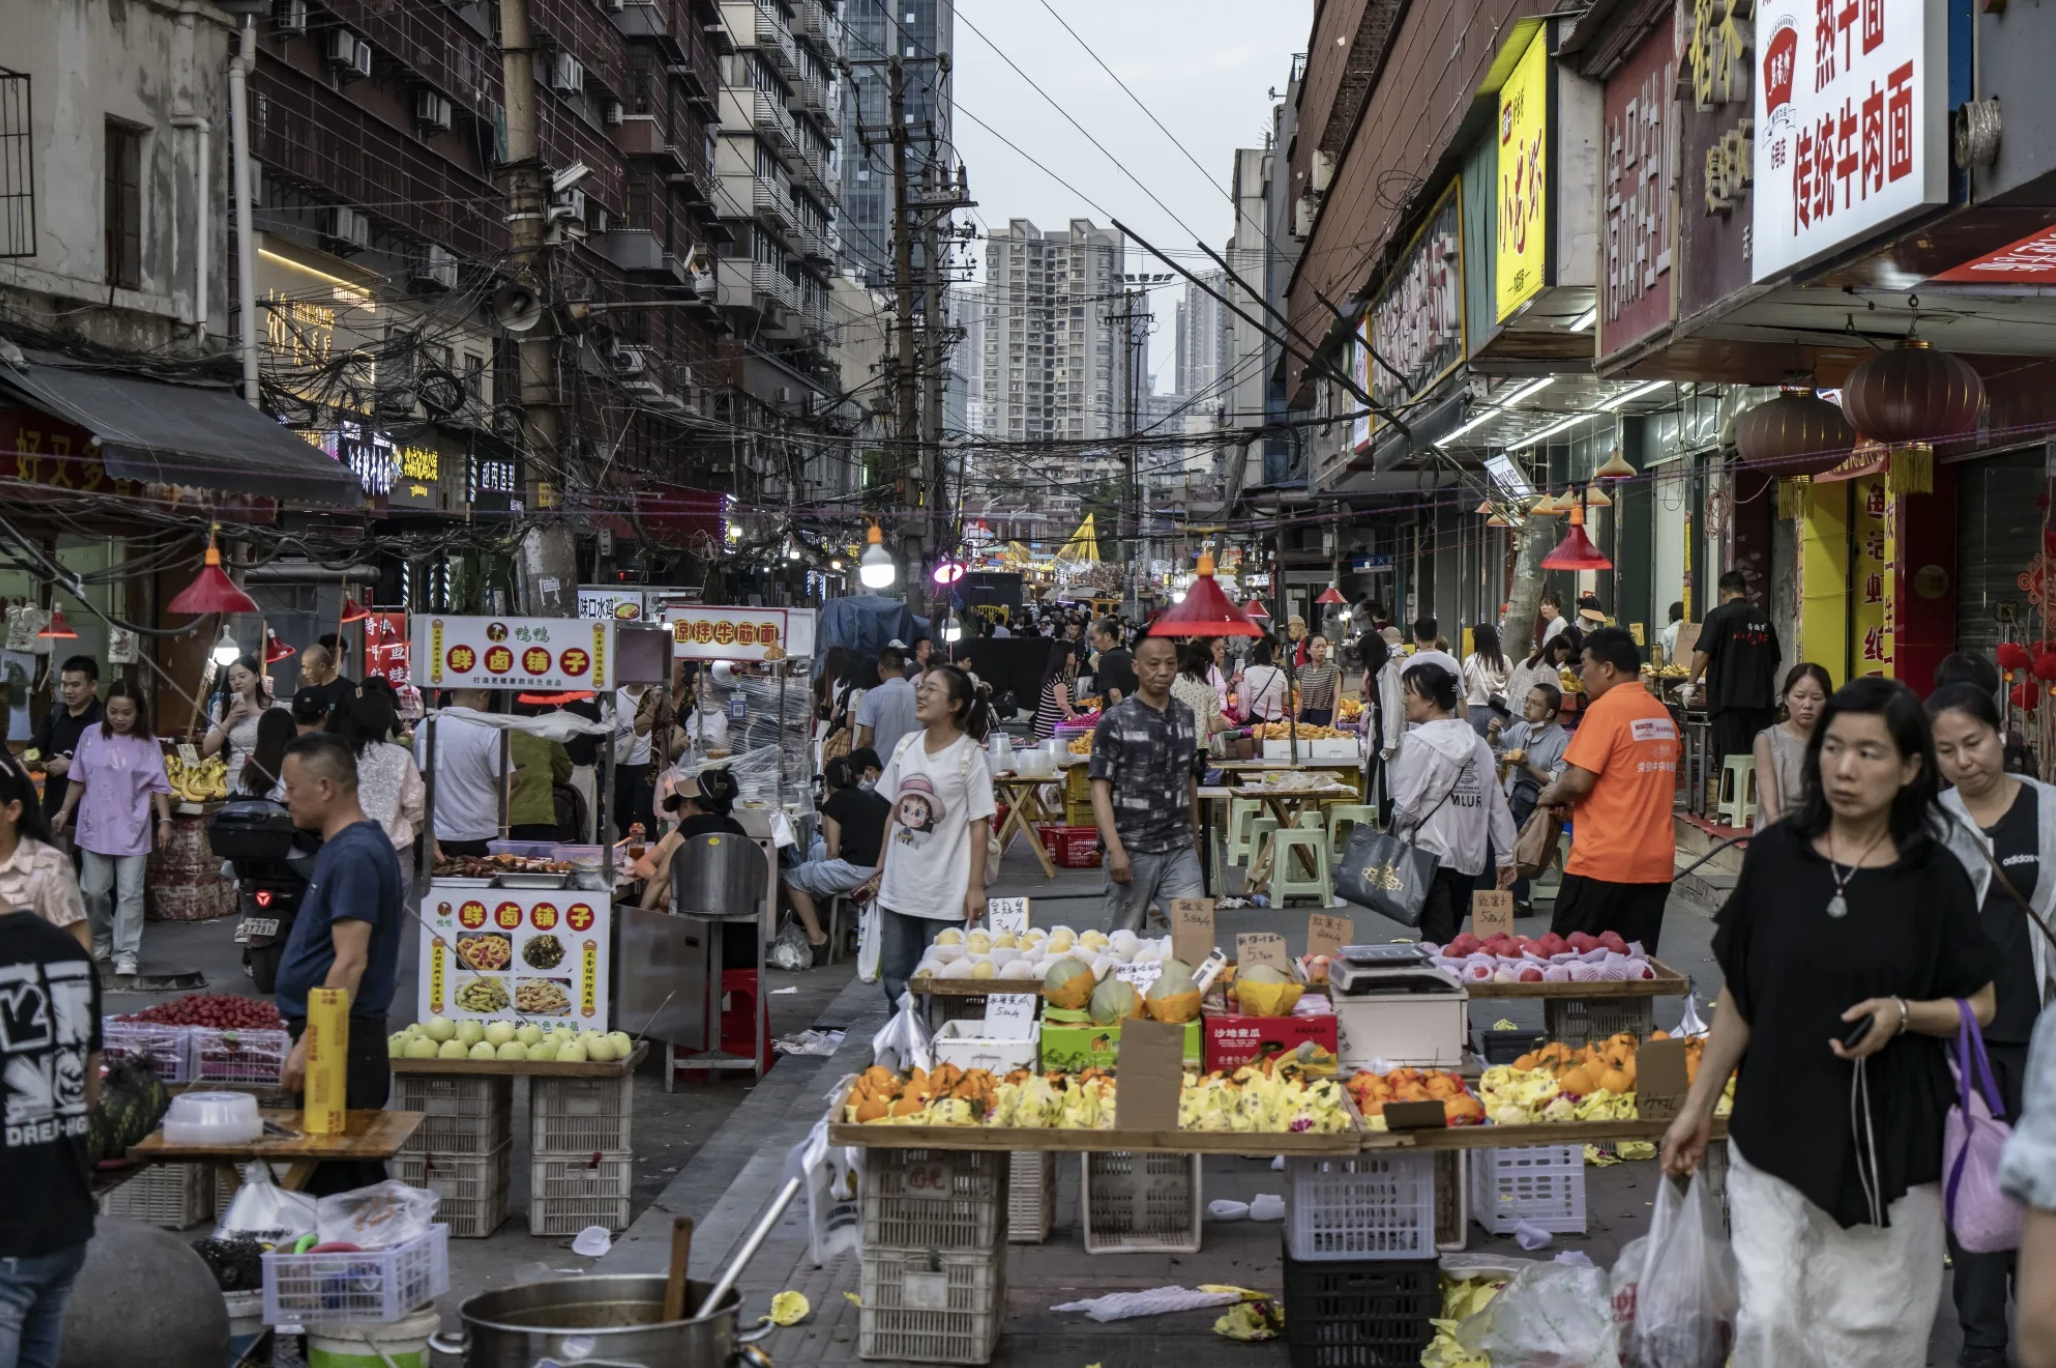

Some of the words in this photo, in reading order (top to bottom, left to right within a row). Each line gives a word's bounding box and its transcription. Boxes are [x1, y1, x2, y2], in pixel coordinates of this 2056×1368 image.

[1770, 137, 1786, 170] 6号店
[1793, 59, 1913, 236] 传统牛肉面
[579, 598, 614, 619] 味口水鸡
[514, 625, 550, 643] 鸭鸭
[674, 621, 777, 645] 凉拌牛筋面
[451, 649, 585, 673] 鲜卤铺子
[473, 676, 562, 687] 打造更健康的绿色食品
[2002, 854, 2035, 867] adidas
[463, 905, 591, 928] 鲜卤铺子
[433, 948, 443, 1002] 真材实料干净卫生
[585, 952, 595, 1005] 不含任何防腐剂
[1213, 1028, 1261, 1038] 沙地蜜瓜
